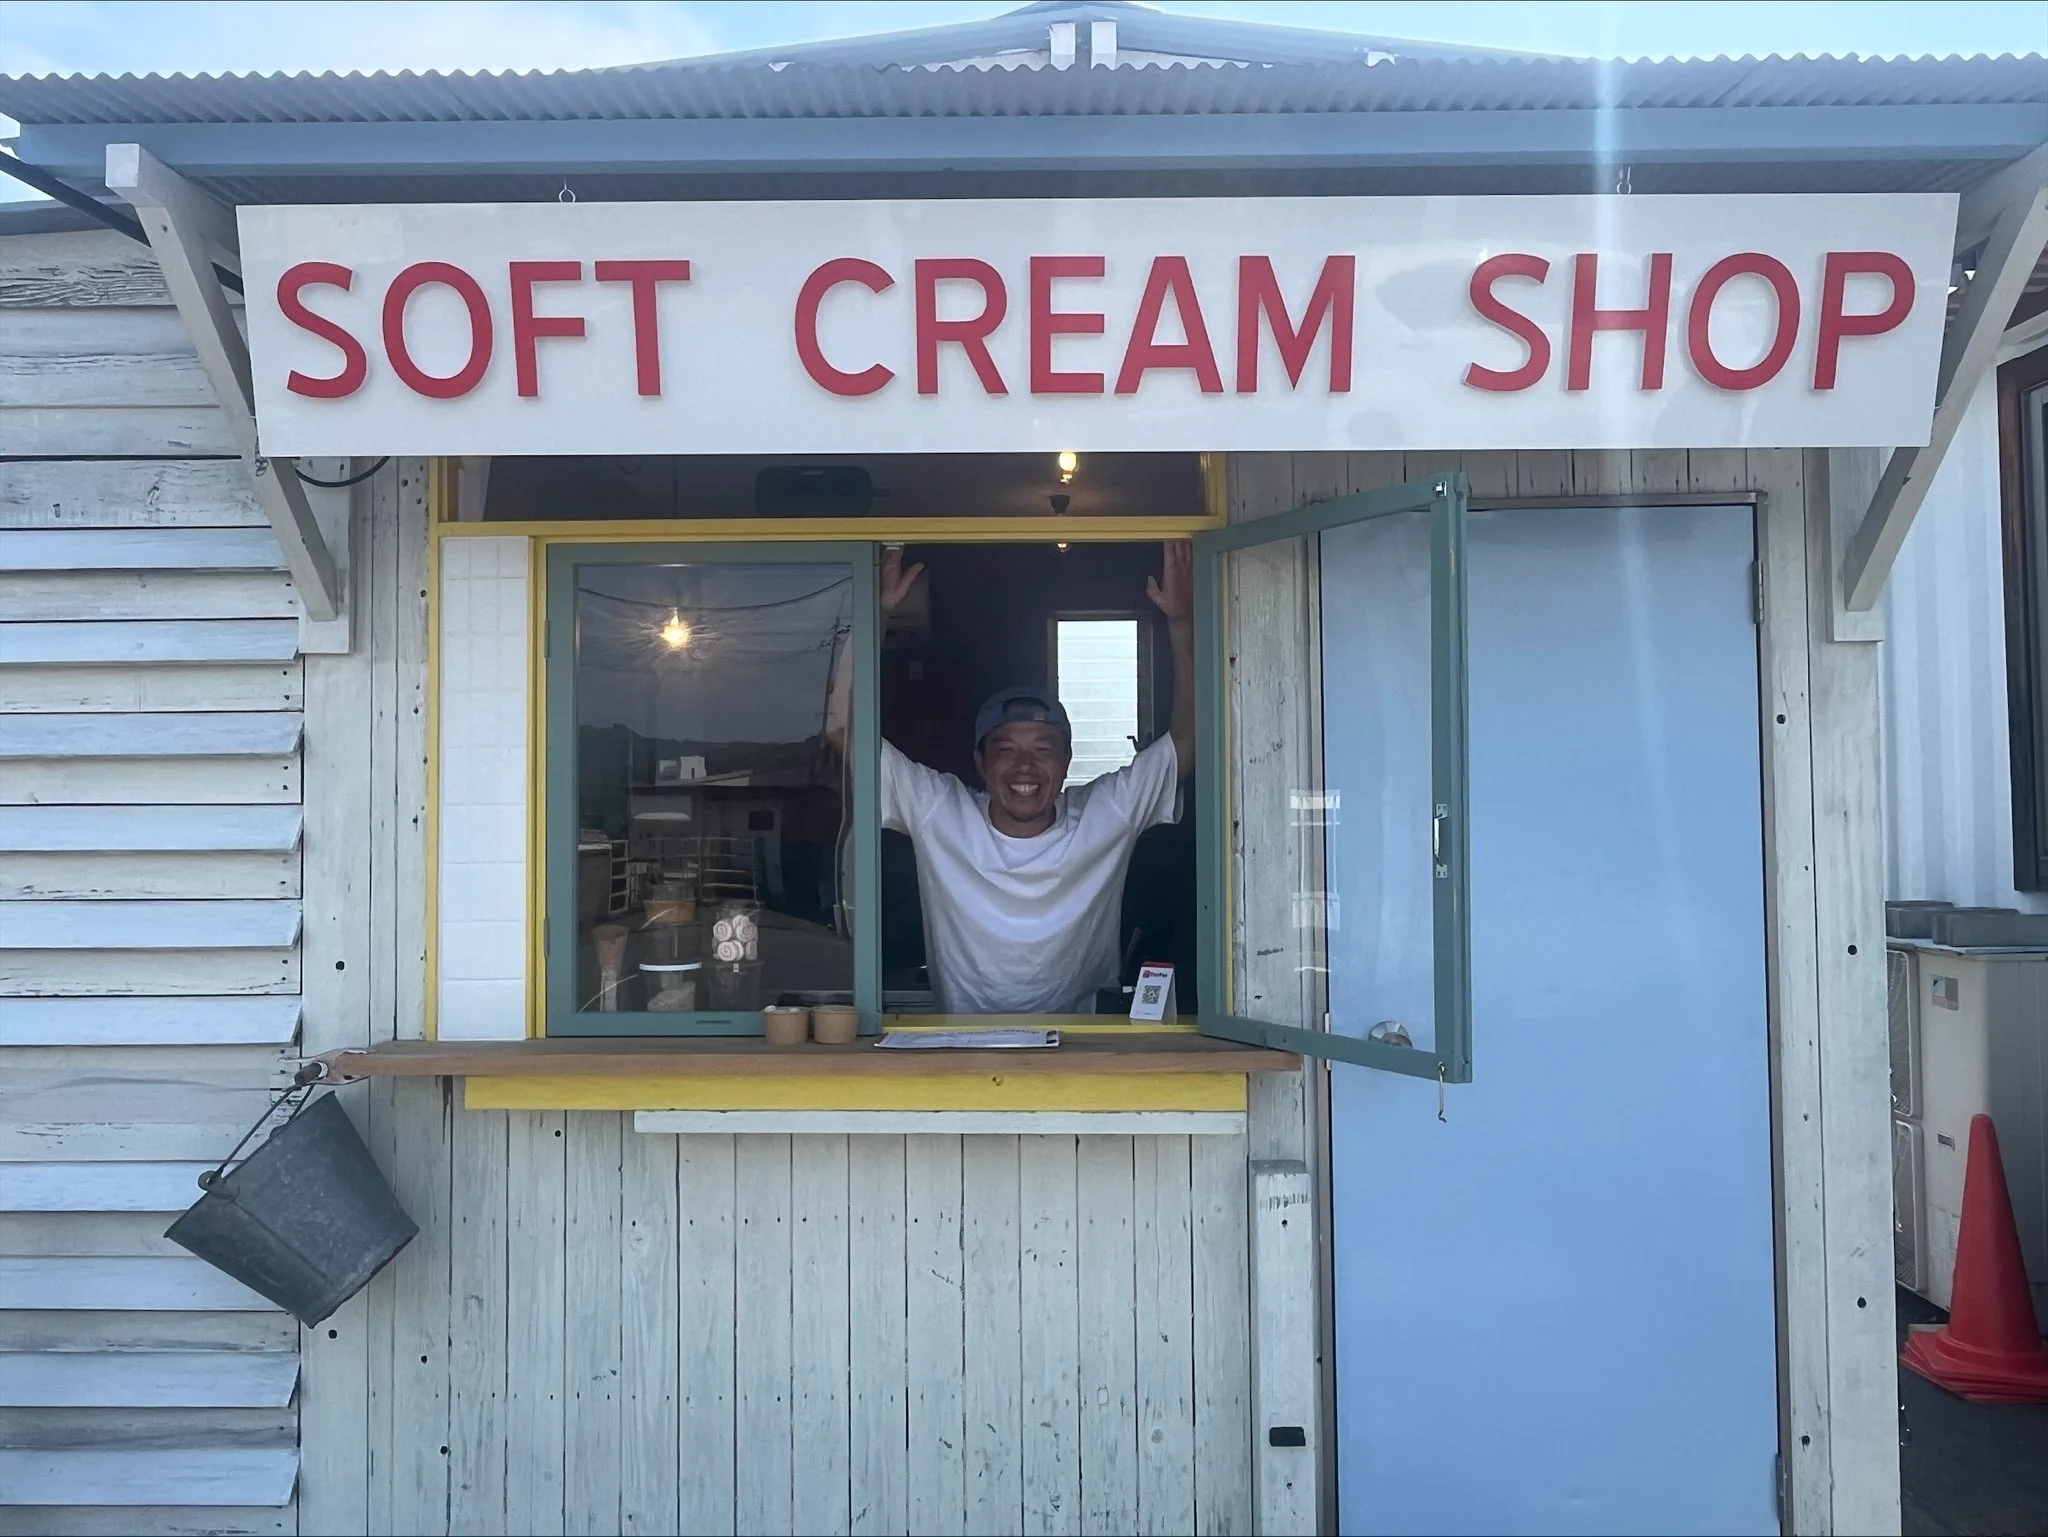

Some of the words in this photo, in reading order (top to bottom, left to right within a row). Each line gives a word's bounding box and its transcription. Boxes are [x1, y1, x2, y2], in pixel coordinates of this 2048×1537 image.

[276, 260, 691, 398] SOFT
[795, 256, 1354, 395] CREAM
[1466, 252, 1915, 391] SHOP
